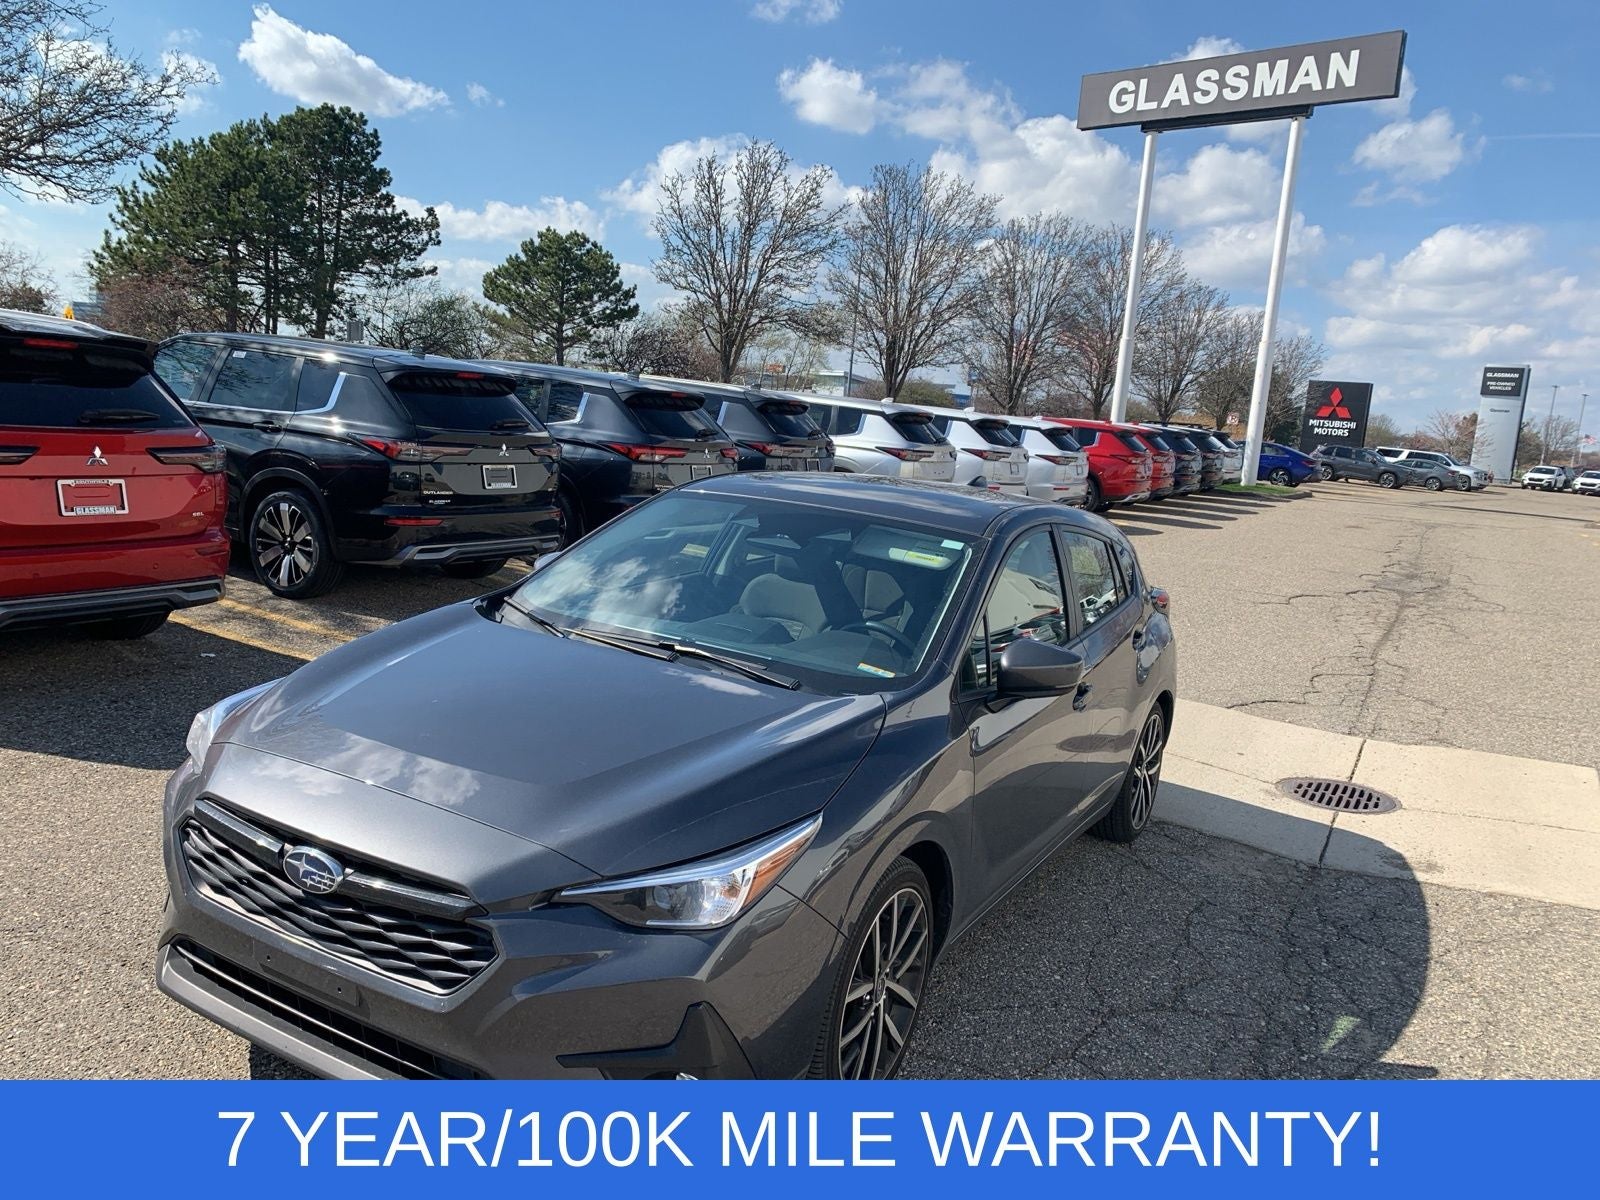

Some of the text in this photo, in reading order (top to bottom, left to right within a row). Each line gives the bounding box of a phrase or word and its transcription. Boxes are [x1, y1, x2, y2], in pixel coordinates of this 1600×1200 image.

[1108, 49, 1360, 114] GLASSMAN
[1308, 419, 1357, 429] MITSUBISHI
[1313, 427, 1349, 437] MOTORS
[75, 506, 115, 515] GLASSMAN
